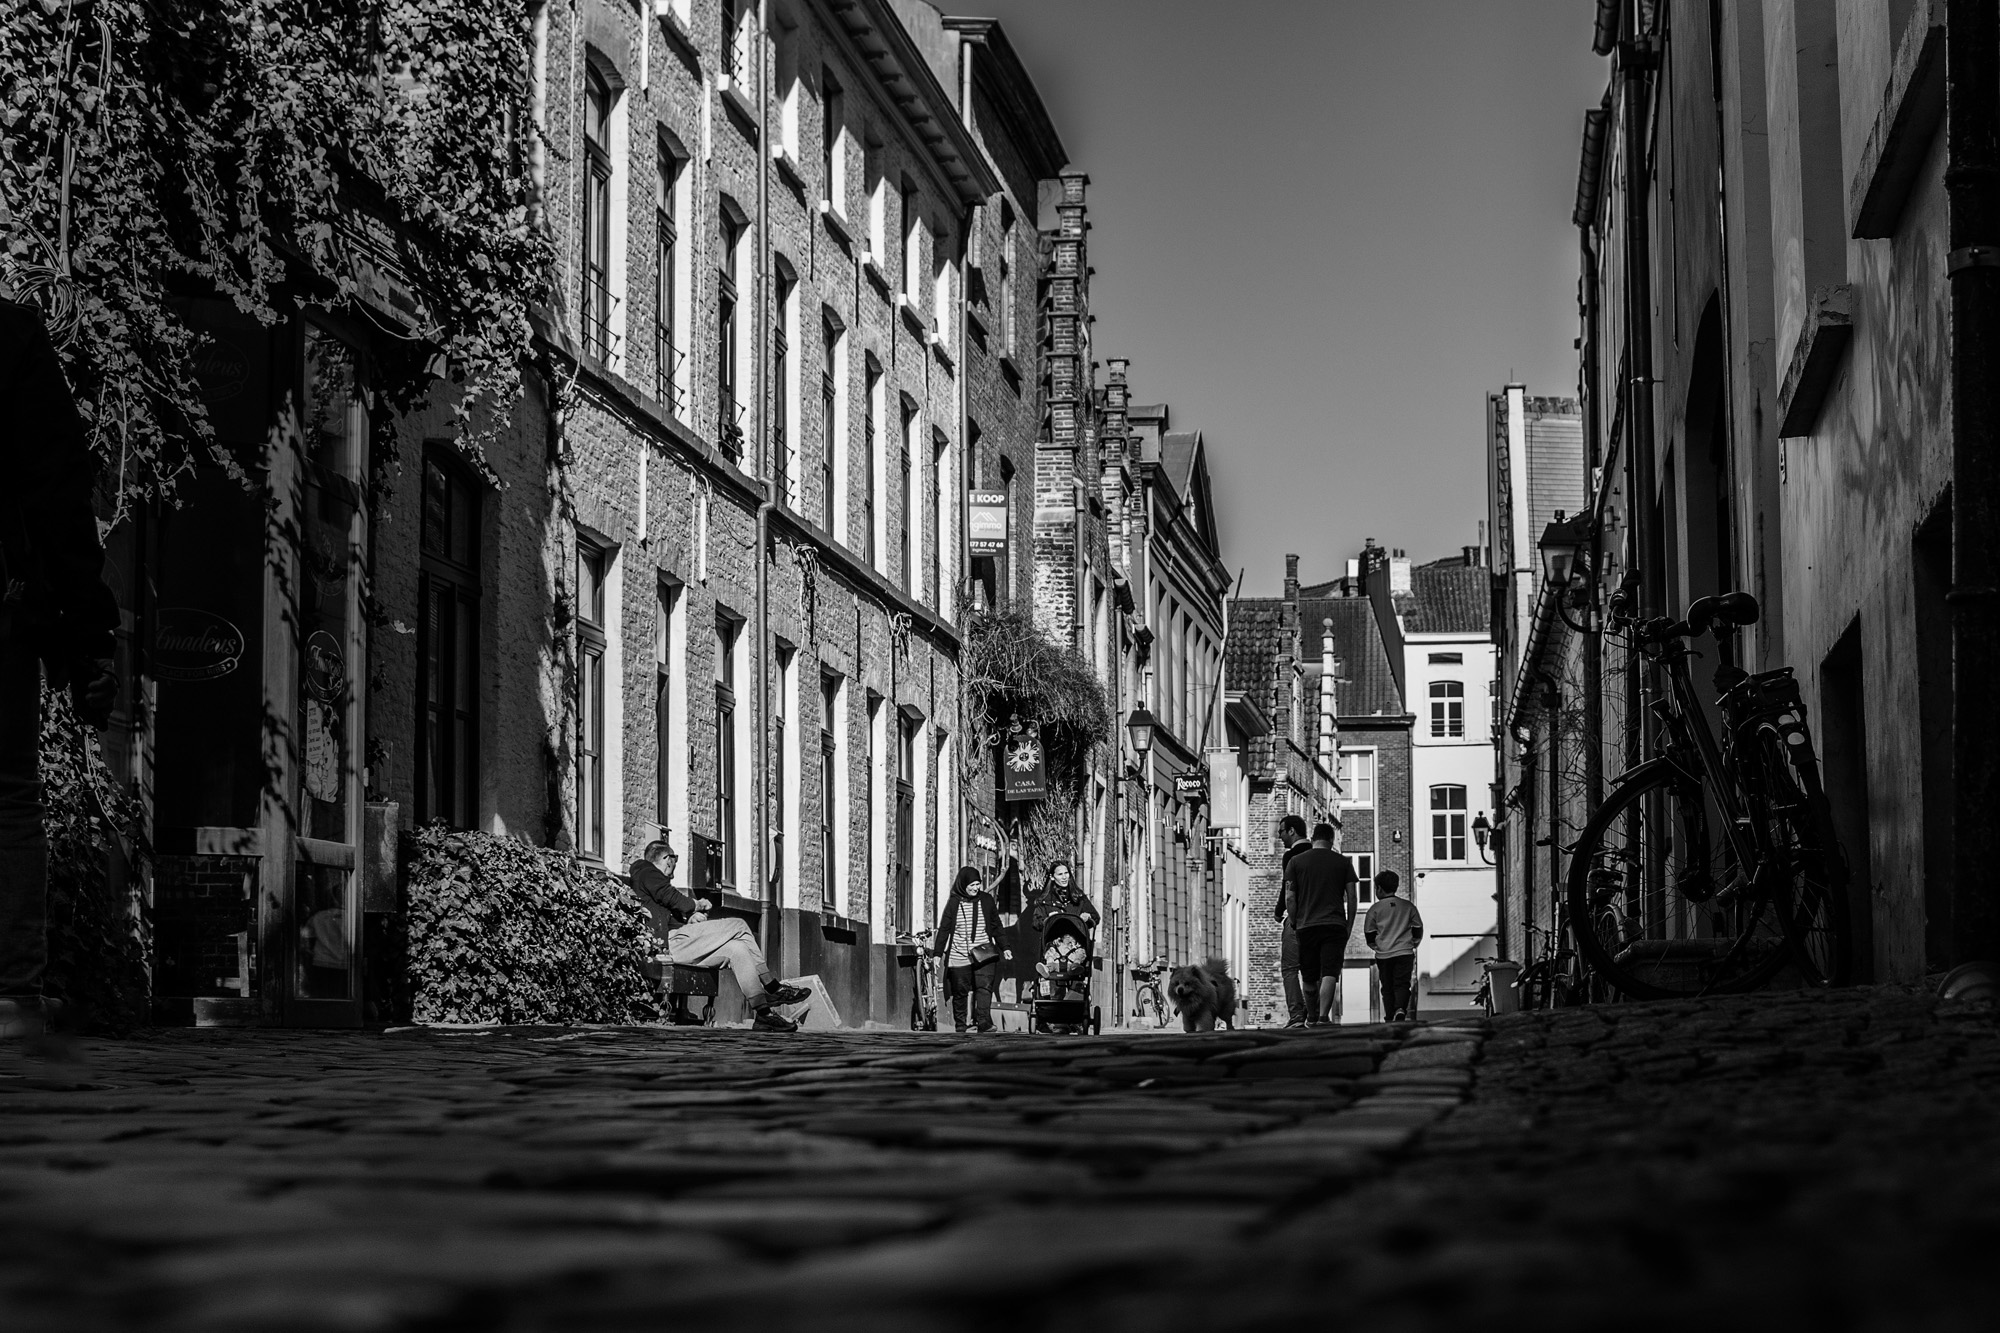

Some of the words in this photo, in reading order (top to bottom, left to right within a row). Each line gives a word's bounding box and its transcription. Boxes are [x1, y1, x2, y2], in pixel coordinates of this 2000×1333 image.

[969, 494, 974, 503] E
[977, 494, 1004, 503] KOOP
[207, 664, 227, 676] RIBS
